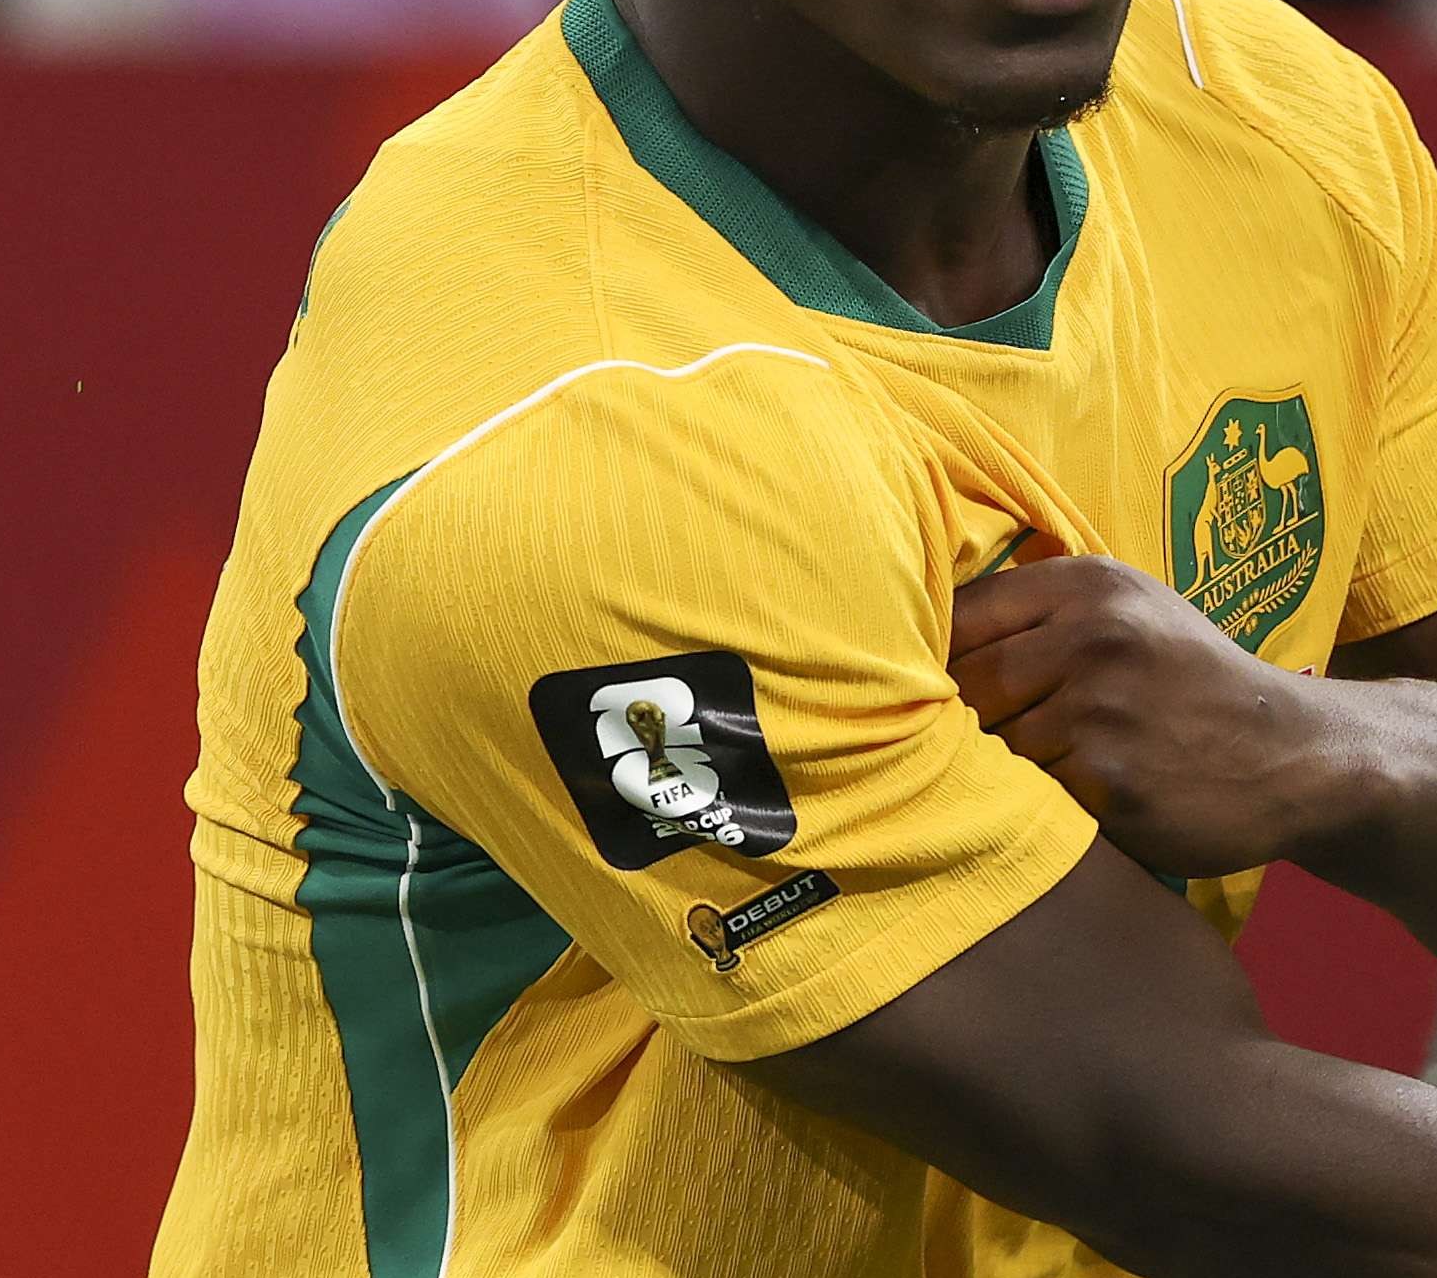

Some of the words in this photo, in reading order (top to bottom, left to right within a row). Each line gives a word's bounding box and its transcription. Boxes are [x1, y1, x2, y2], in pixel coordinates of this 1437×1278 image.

[1203, 533, 1301, 616] AUSTRALIA
[649, 782, 695, 810] FIFA
[699, 807, 733, 830] CUP
[727, 874, 816, 933] DEBUT
